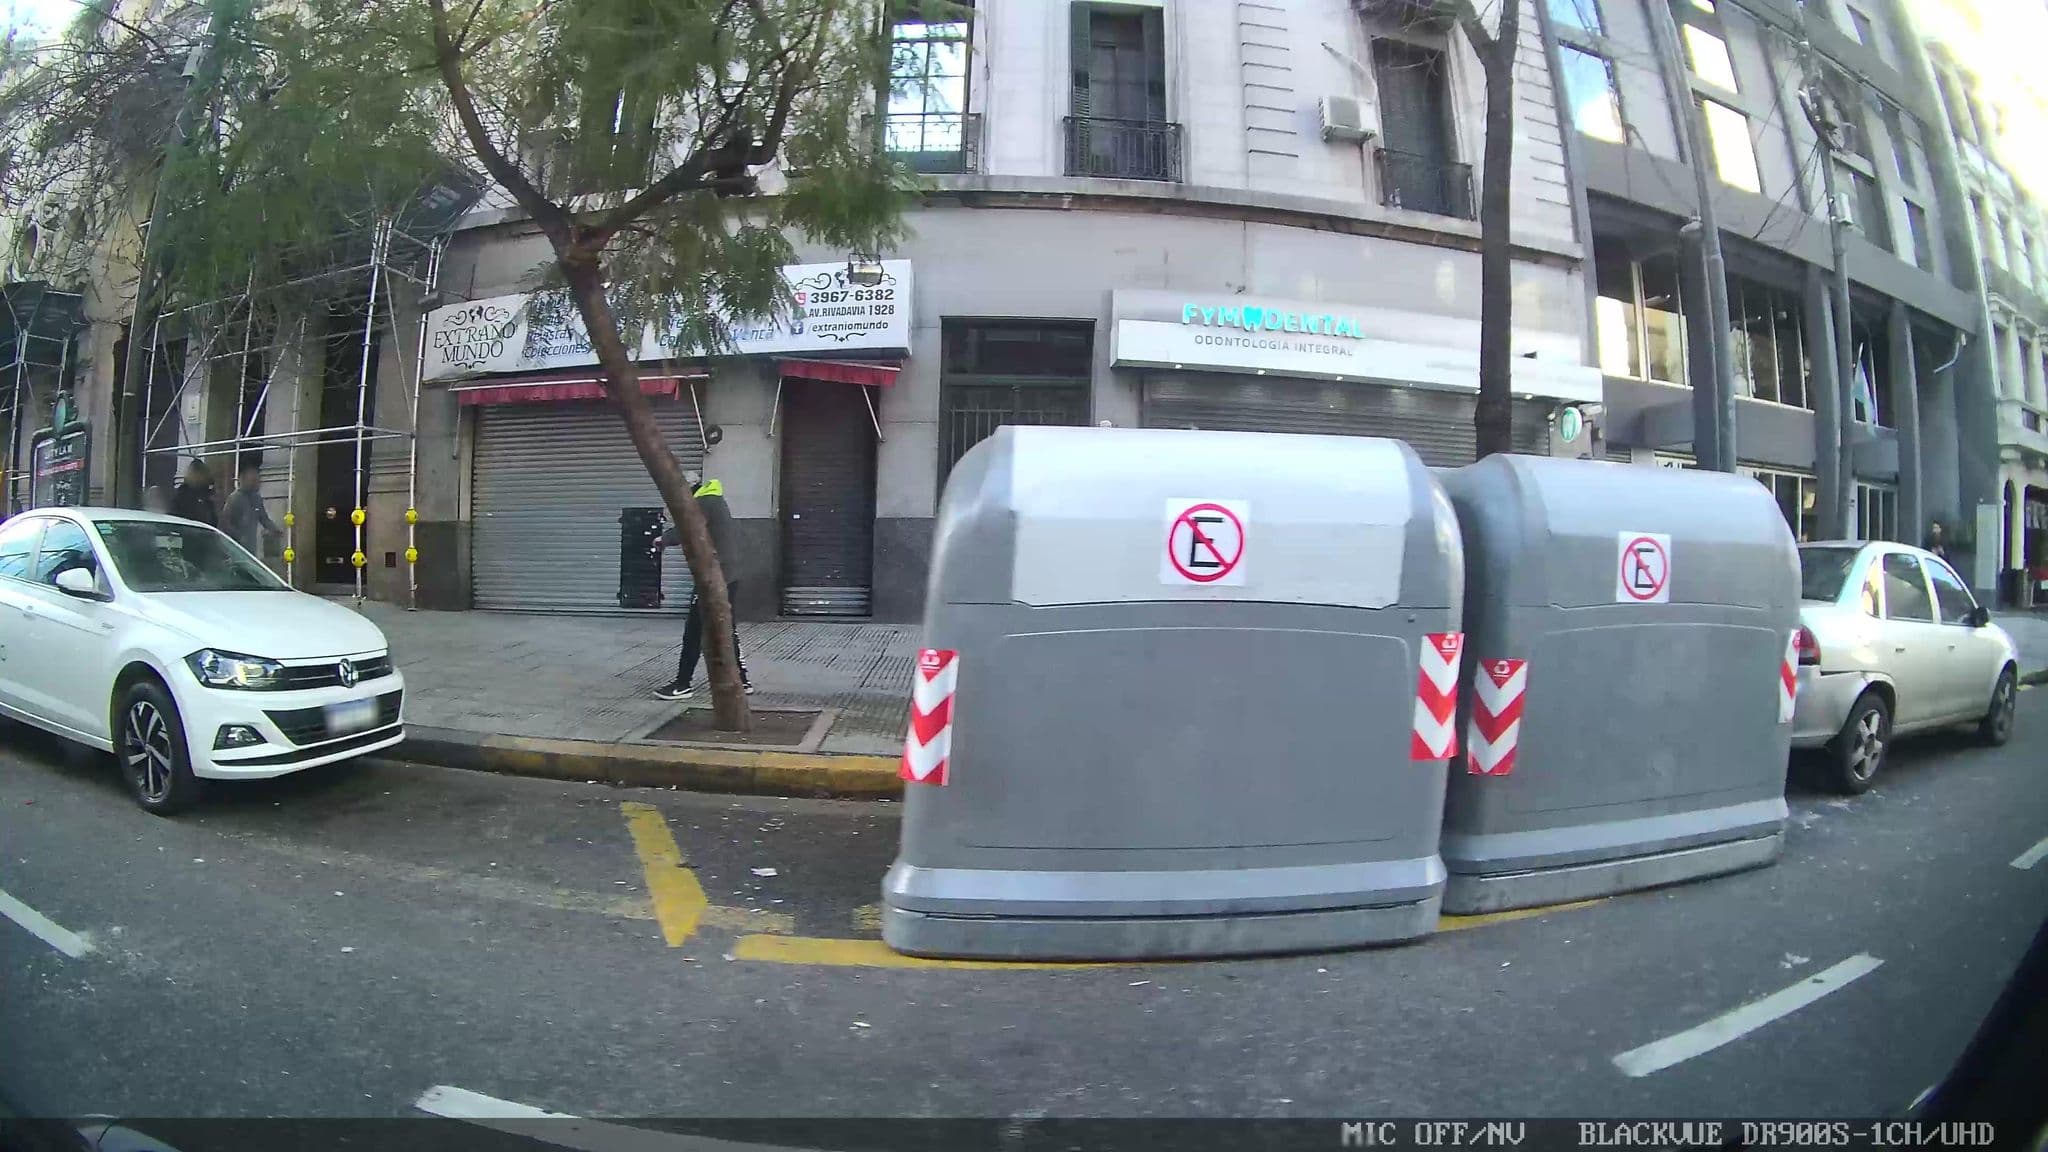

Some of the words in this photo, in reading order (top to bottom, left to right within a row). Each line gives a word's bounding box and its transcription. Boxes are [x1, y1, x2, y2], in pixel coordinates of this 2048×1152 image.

[810, 288, 895, 304] 3967-6382
[868, 304, 895, 316] 1928
[1182, 303, 1242, 329] FYM
[1264, 309, 1366, 339] DENTAL
[441, 340, 503, 364] MUNDO
[1294, 341, 1354, 358] INTEGRAL
[1189, 516, 1225, 568] E
[1634, 547, 1655, 589] E
